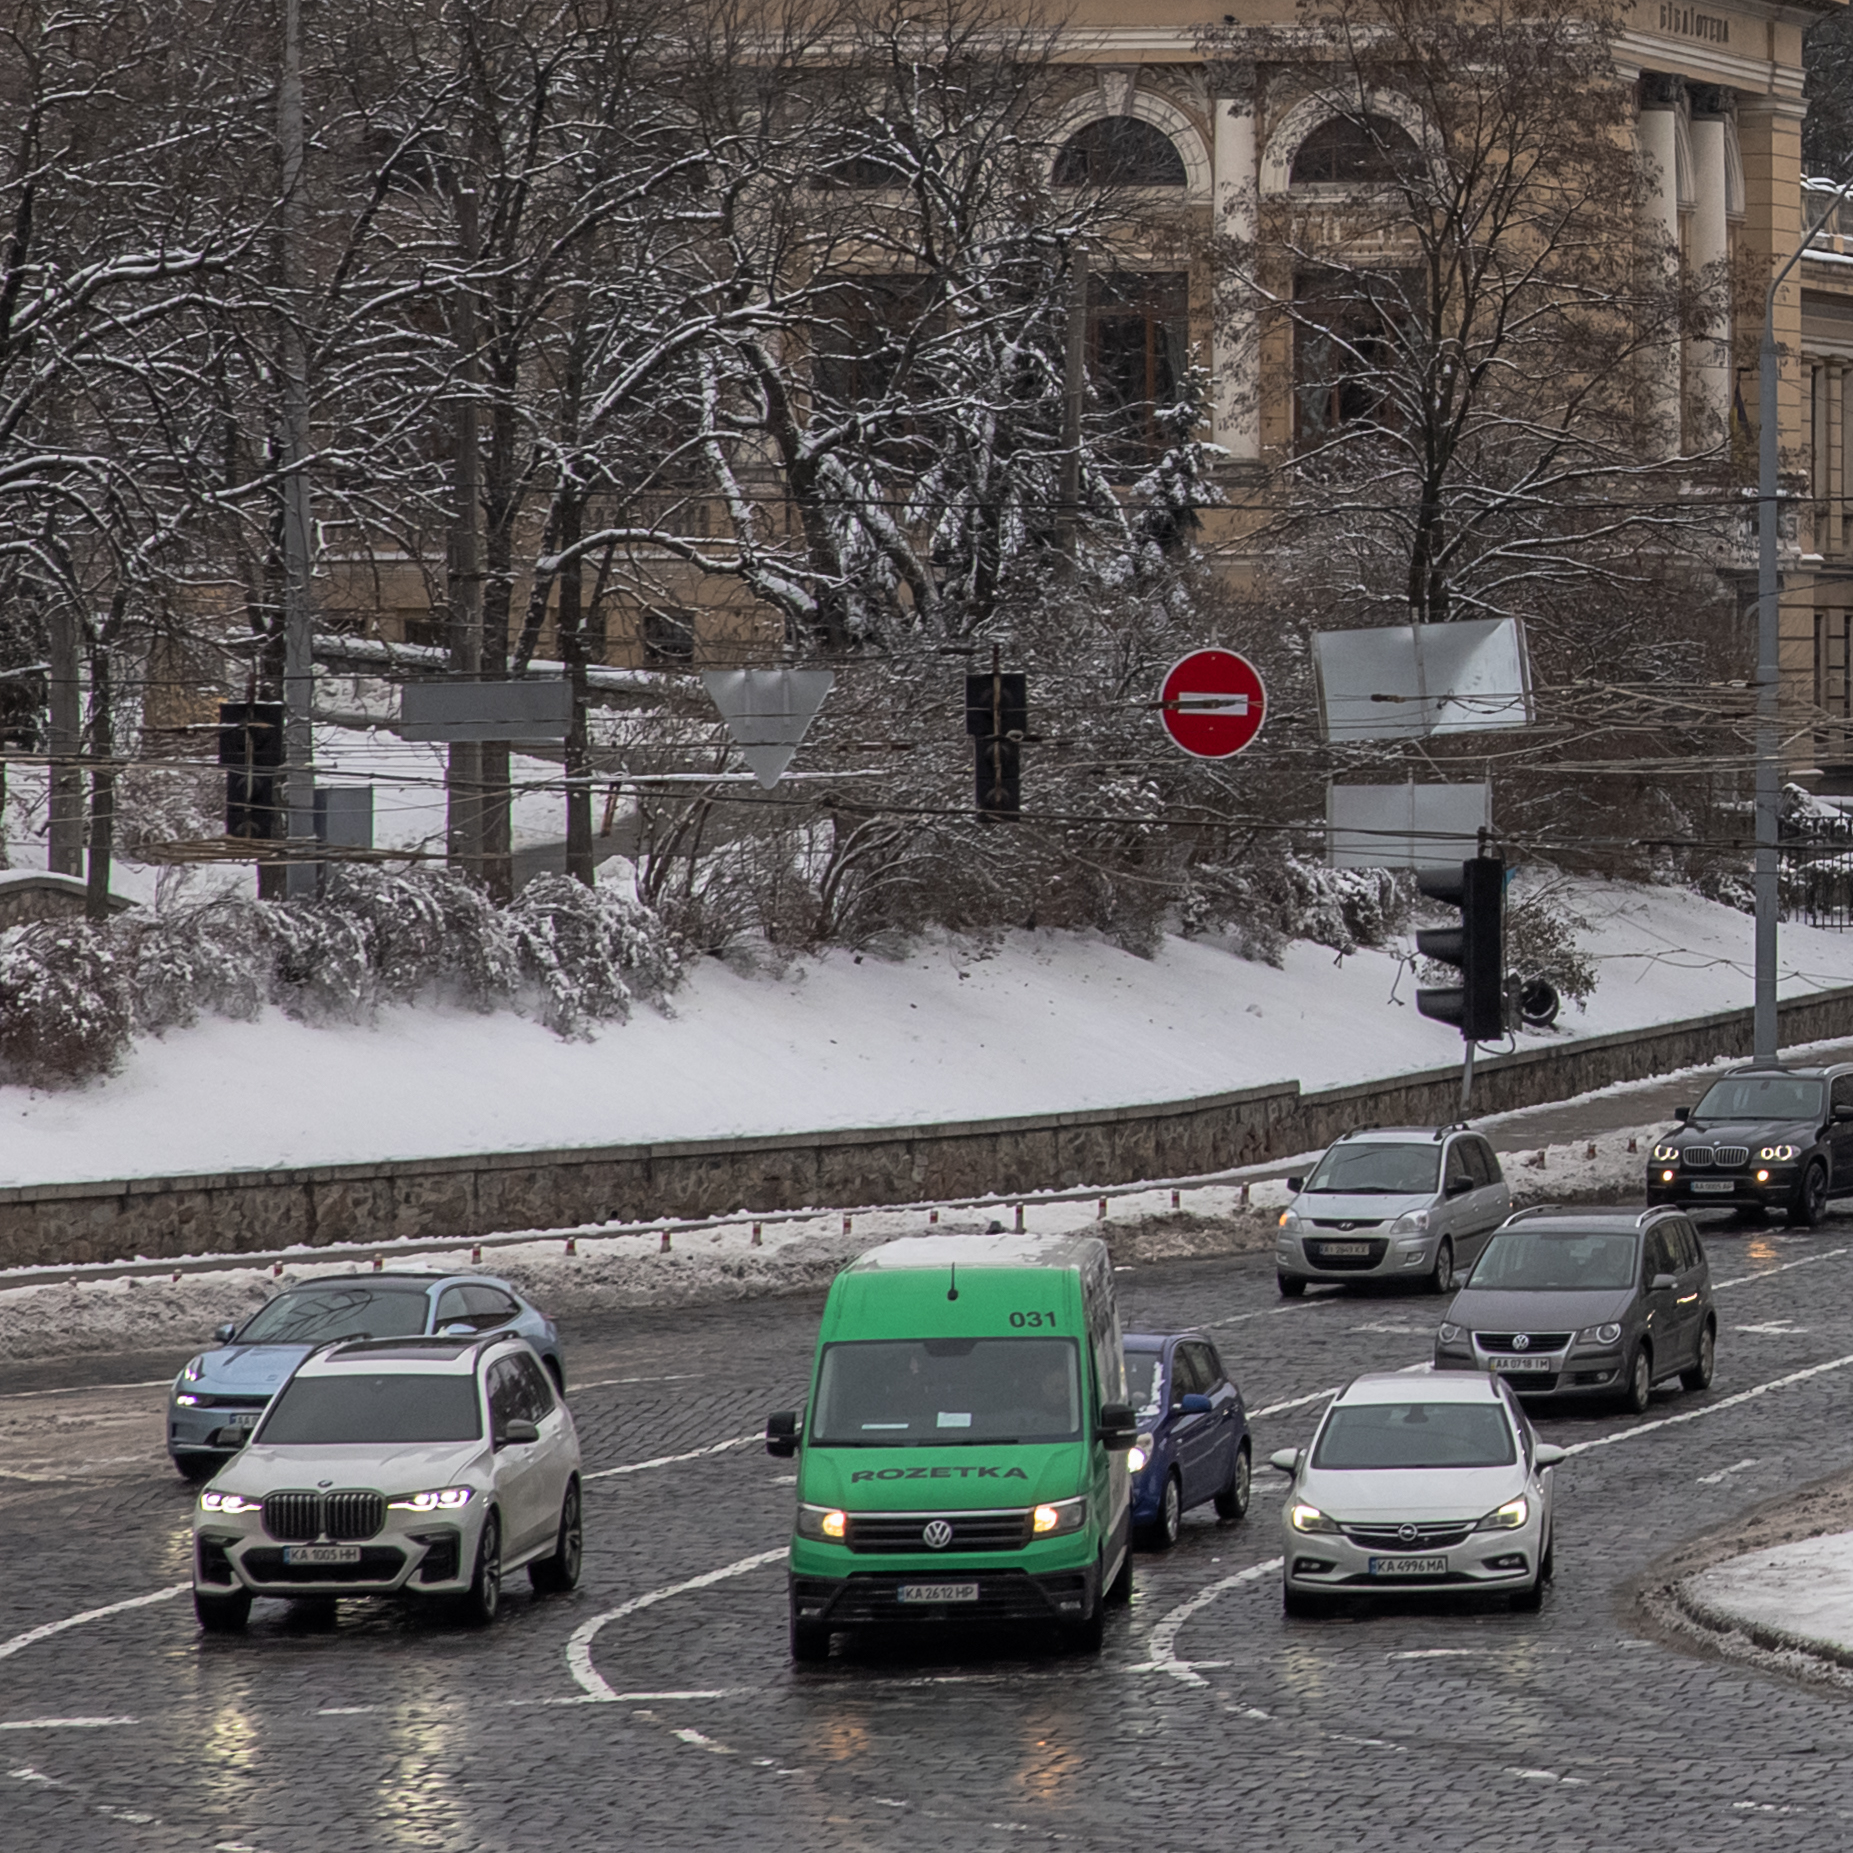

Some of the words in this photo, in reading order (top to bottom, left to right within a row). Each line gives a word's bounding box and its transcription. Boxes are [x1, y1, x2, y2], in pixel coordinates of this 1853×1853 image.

[1008, 1311, 1057, 1328] 031
[1496, 1359, 1509, 1369] AA
[851, 1466, 1029, 1483] ROZETKA
[291, 1547, 308, 1560] KA
[312, 1547, 337, 1560] 1005
[339, 1547, 357, 1560] HH
[1377, 1560, 1395, 1573] KA
[1397, 1560, 1425, 1572] 4996
[1427, 1559, 1444, 1571] MA
[905, 1587, 923, 1600] KA
[925, 1587, 953, 1599] 2612
[956, 1586, 974, 1598] HP
